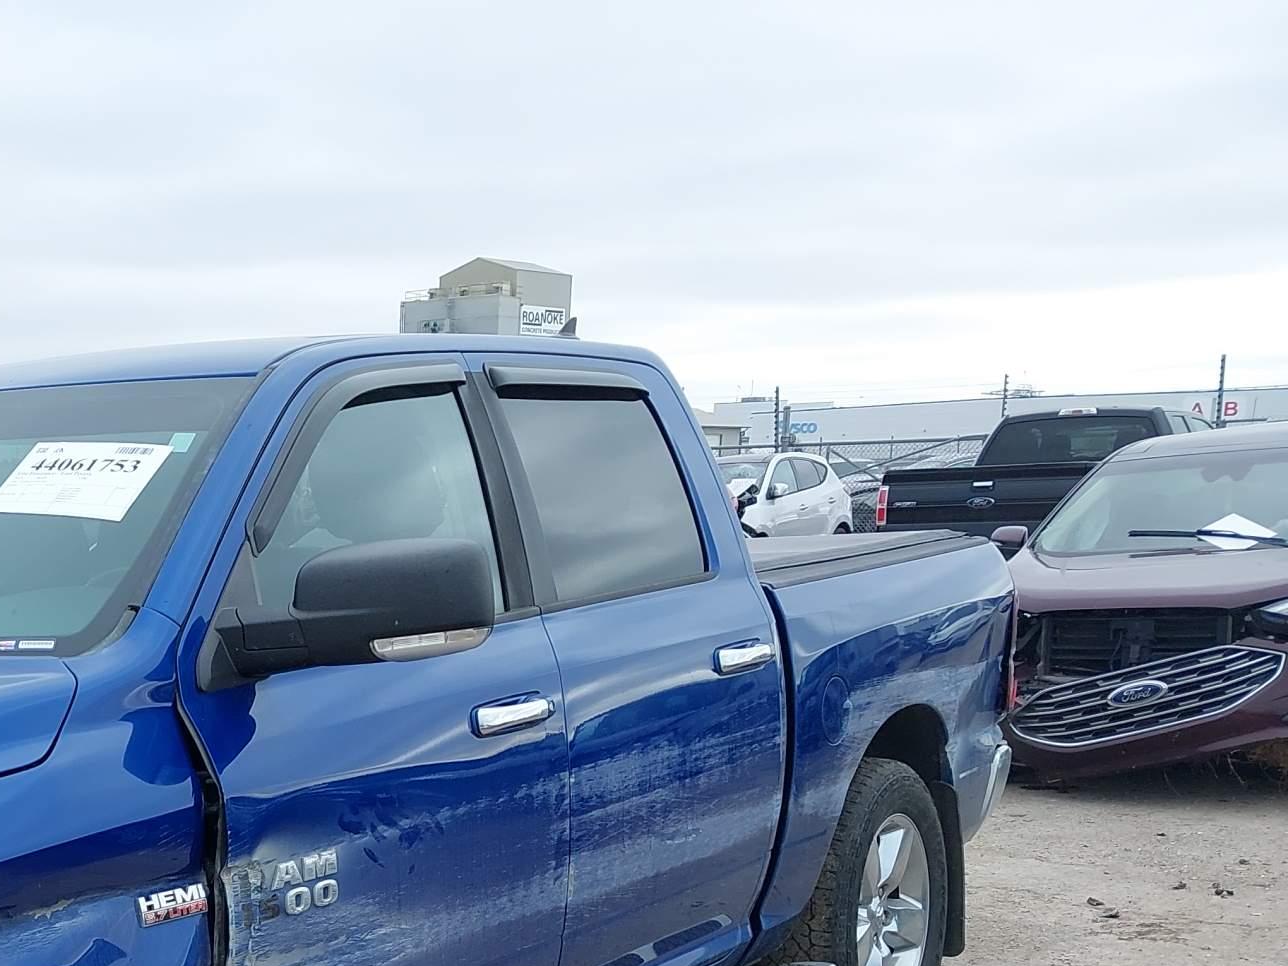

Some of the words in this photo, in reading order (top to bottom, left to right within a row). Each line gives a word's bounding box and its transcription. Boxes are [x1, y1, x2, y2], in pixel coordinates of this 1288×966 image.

[522, 310, 564, 325] ROANOKE
[1223, 401, 1238, 417] B
[31, 457, 142, 474] 44061753
[1121, 686, 1152, 702] Ford
[138, 882, 207, 913] HEMI
[168, 900, 207, 919] LITER
